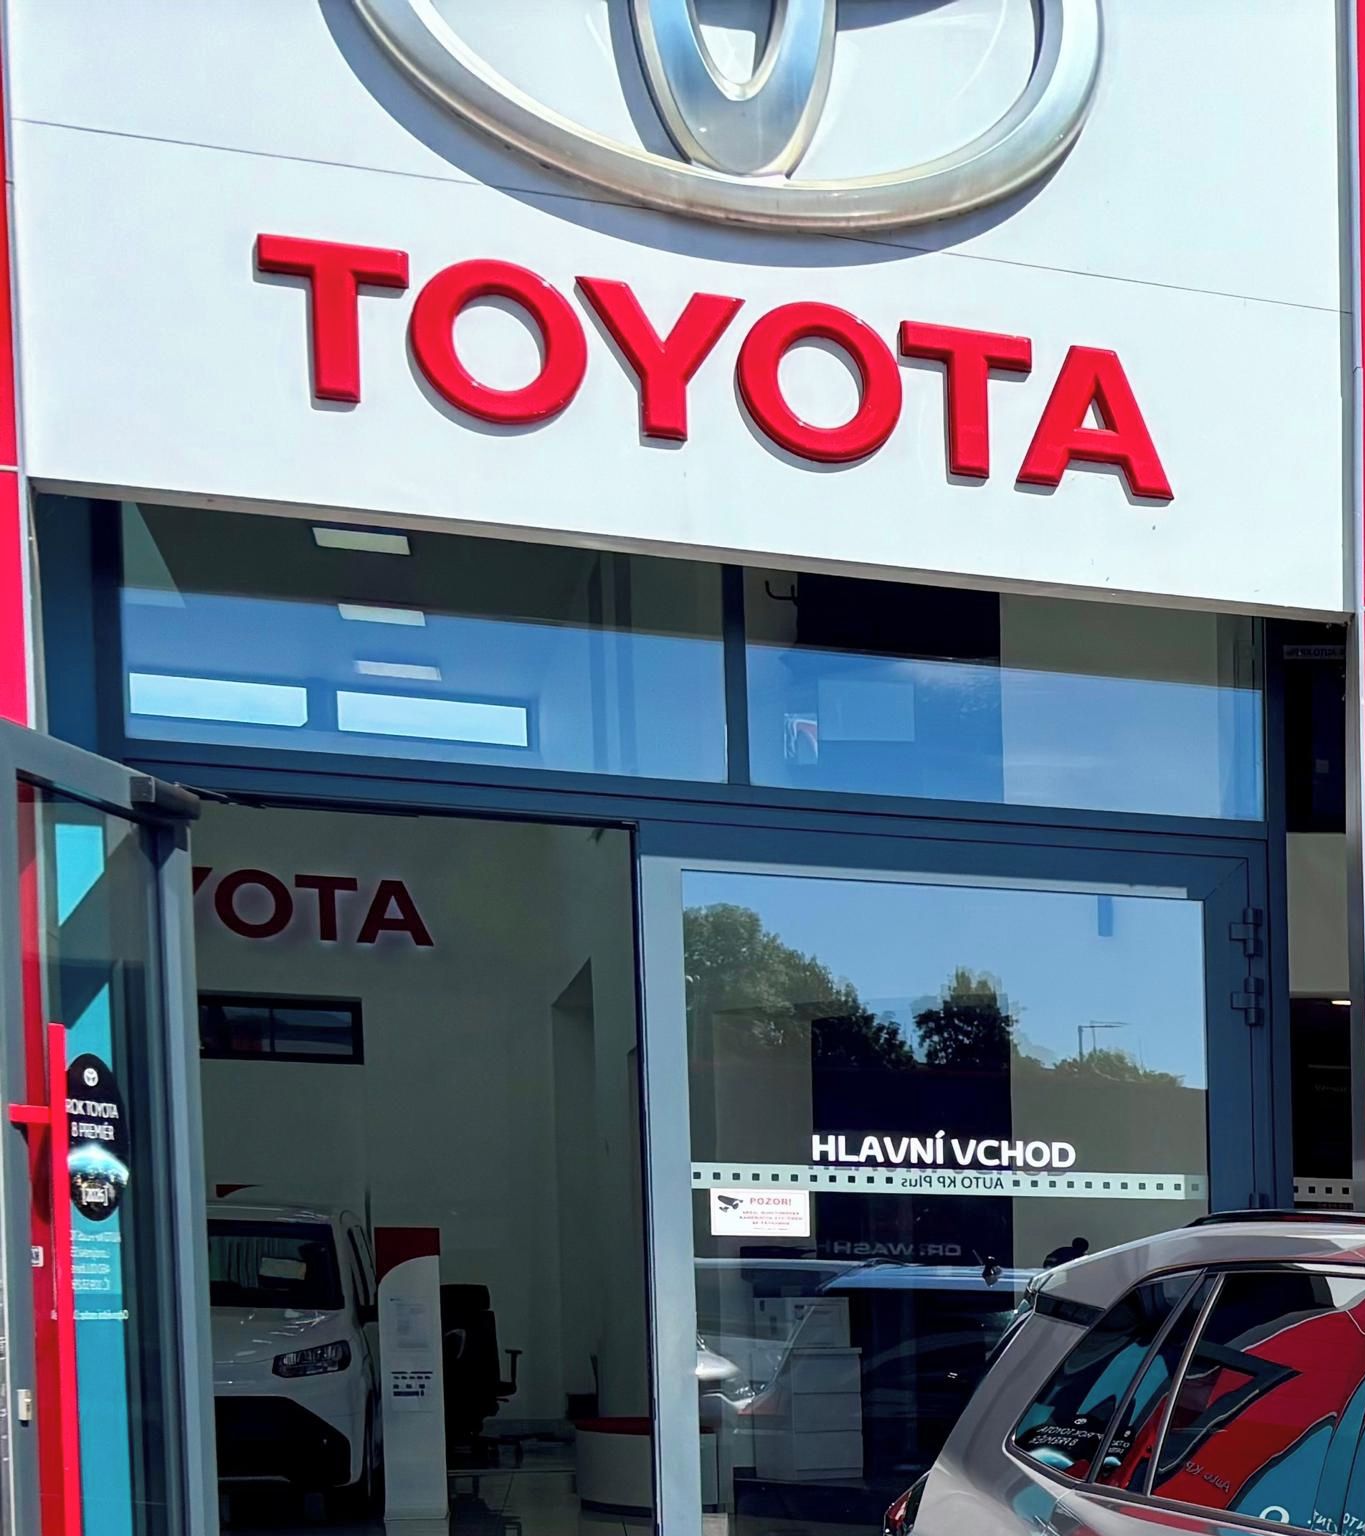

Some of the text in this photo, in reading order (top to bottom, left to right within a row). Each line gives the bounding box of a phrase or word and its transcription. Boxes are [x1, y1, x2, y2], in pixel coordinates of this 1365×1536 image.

[256, 233, 1175, 502] TOYOTA
[192, 866, 434, 948] OTA
[812, 1129, 1076, 1168] HLAVNÍ VCHOD
